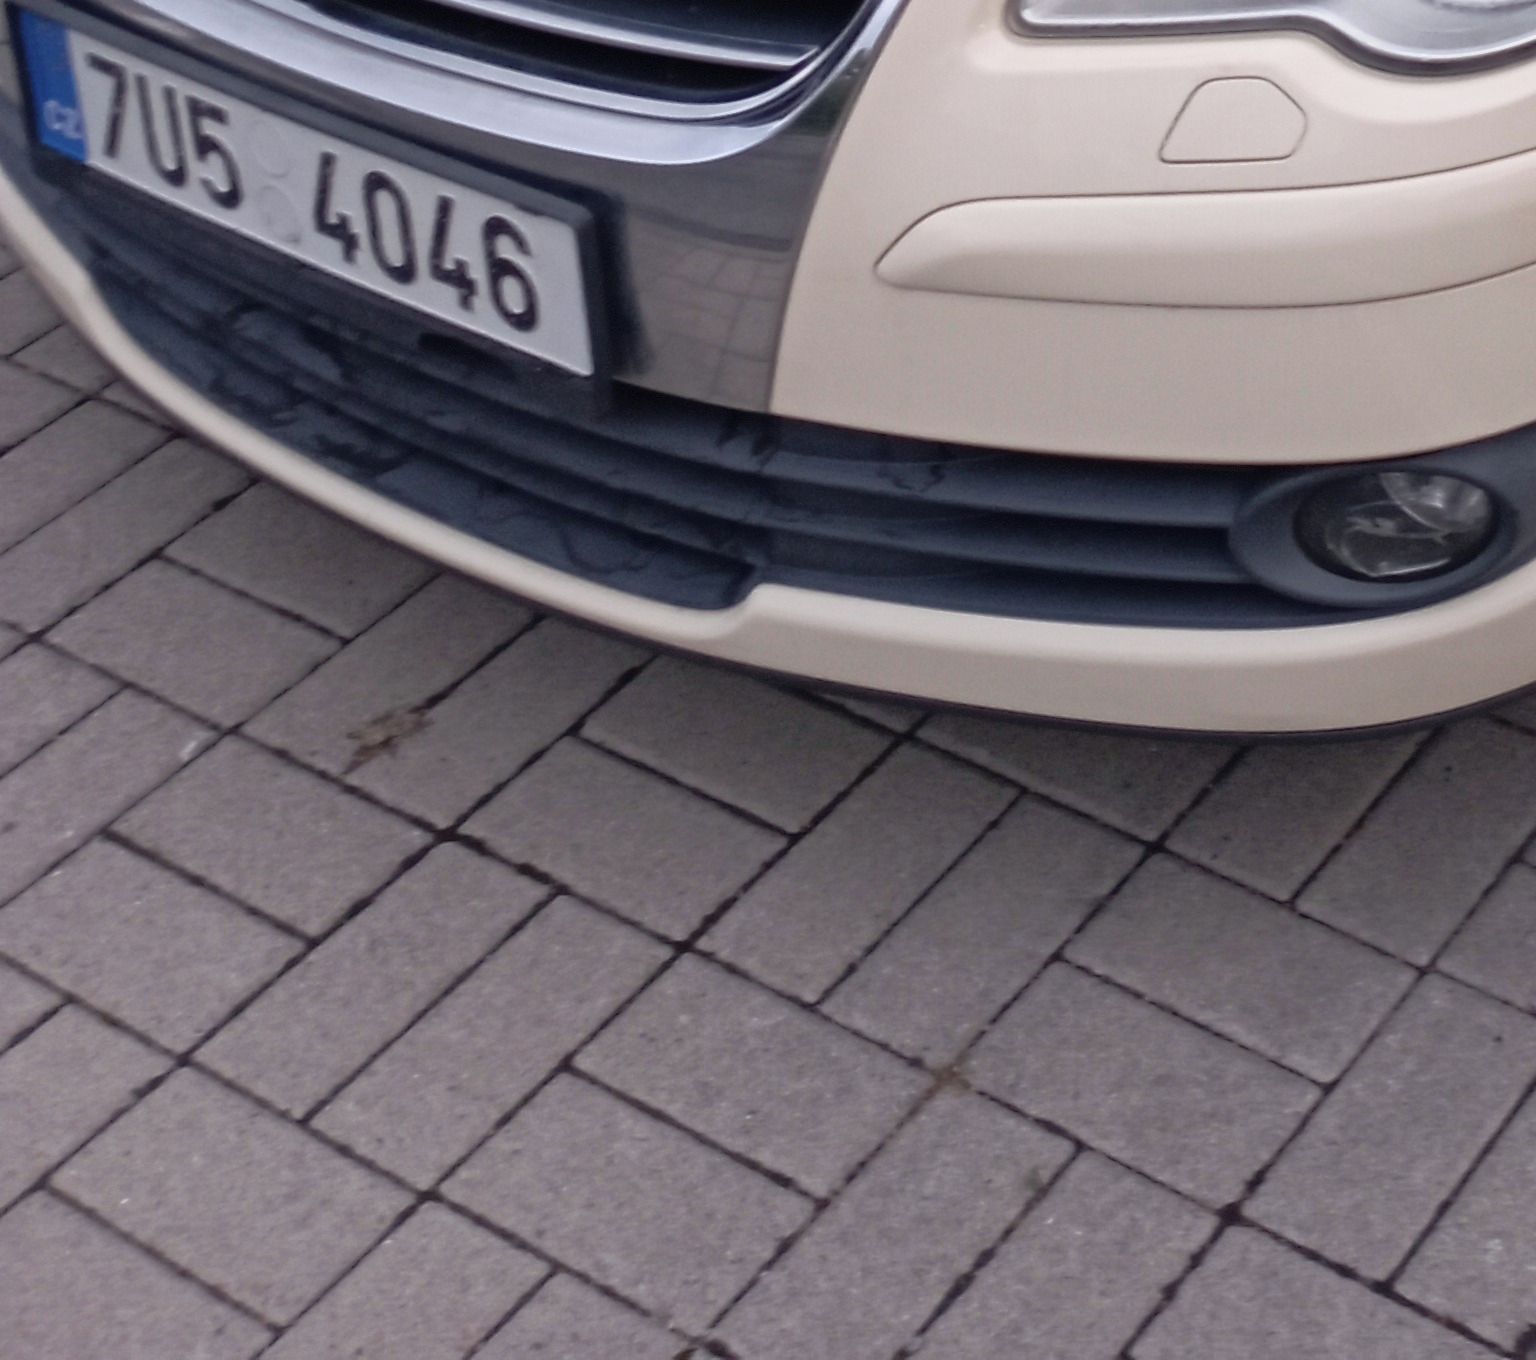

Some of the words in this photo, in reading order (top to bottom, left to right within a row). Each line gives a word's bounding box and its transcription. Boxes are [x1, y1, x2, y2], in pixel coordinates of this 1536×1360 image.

[43, 100, 83, 139] CZ
[87, 53, 243, 209] 7U5
[315, 151, 539, 333] 4046
